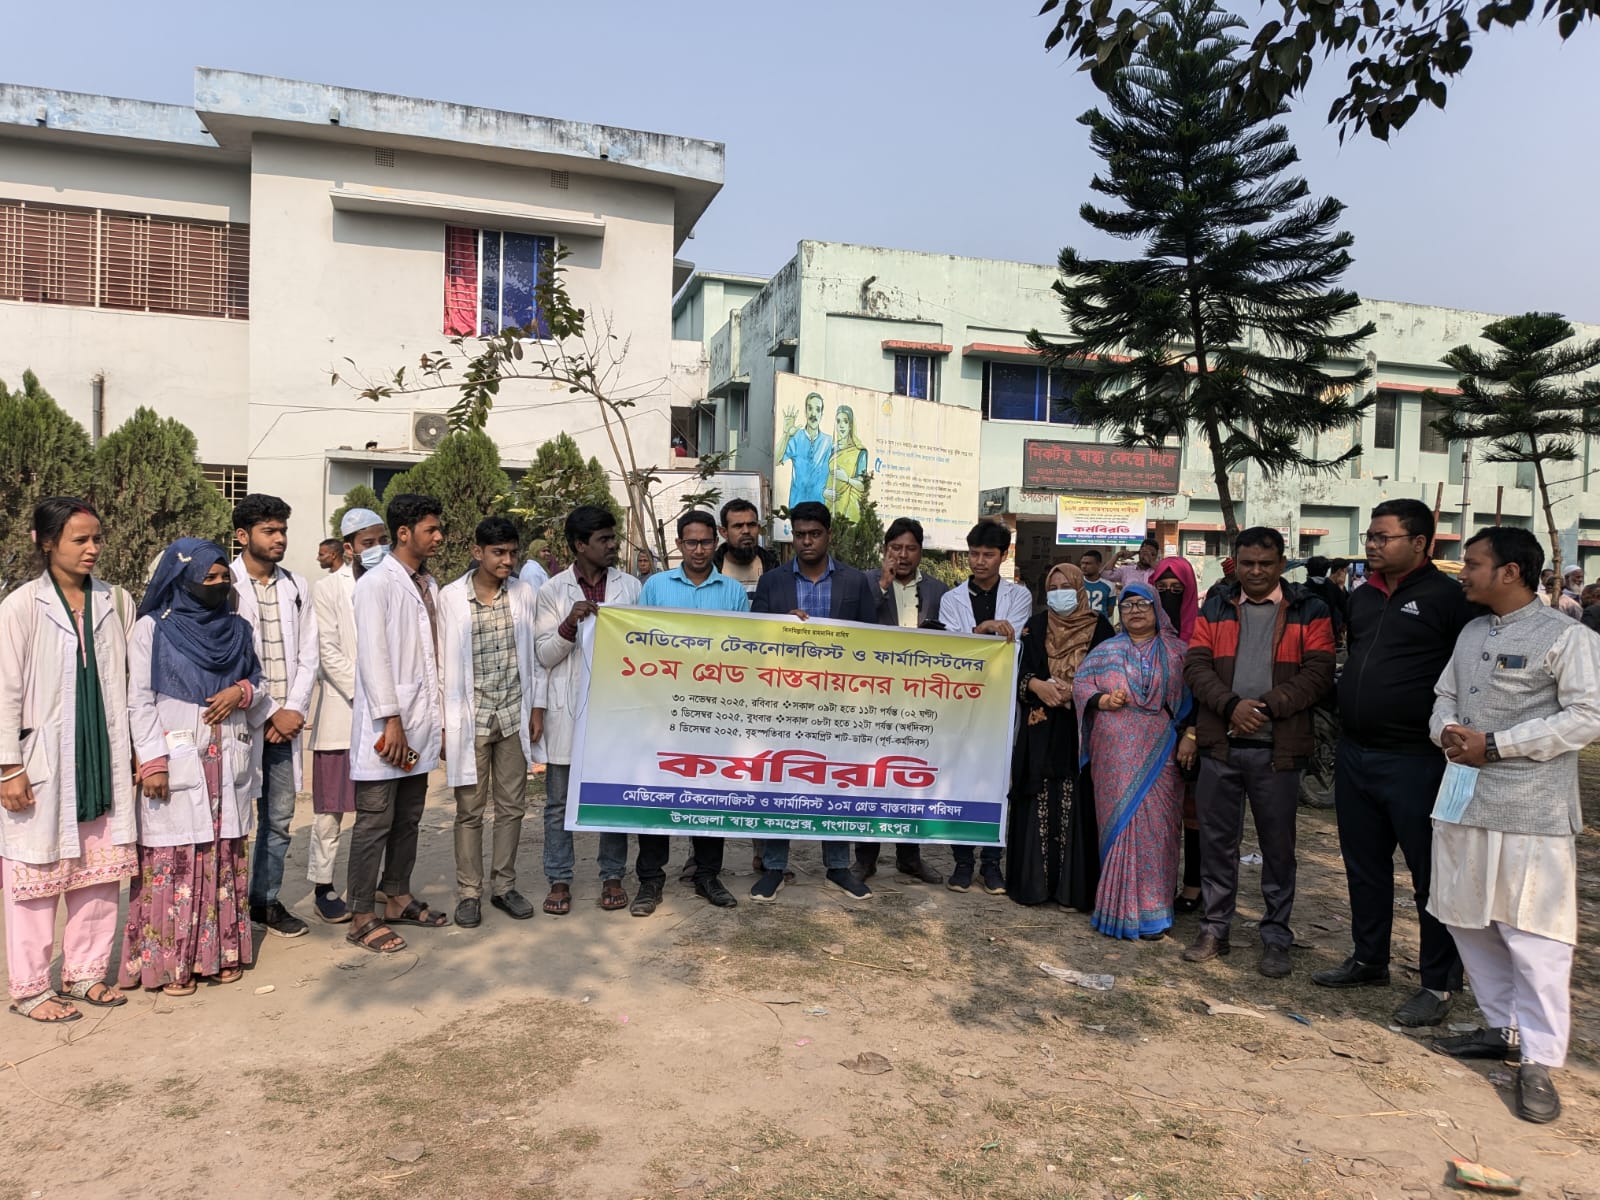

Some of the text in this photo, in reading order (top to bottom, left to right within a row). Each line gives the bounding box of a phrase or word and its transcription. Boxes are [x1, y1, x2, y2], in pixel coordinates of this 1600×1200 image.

[625, 628, 986, 671] মেডিকেল টেকনোলজিস্ট ও ফার্মাসিস্টদের
[621, 656, 986, 700] ১০ম গ্রেড বাস্তবায়নের দাবীতে
[672, 694, 685, 702] ৩০
[688, 694, 717, 705] নভেম্বর
[752, 697, 778, 708] রবিবার
[792, 701, 815, 712] সকাল
[840, 704, 856, 714] হতে
[880, 706, 898, 716] পর্যন্ত
[679, 722, 711, 734] ডিসেম্বর
[745, 727, 791, 739] বৃহস্পতিবার
[681, 707, 713, 720] ডিসেম্বর
[747, 713, 772, 724] বুধবার
[785, 716, 808, 725] সকাল
[834, 719, 850, 728] হতে
[853, 720, 872, 729] ১২টা
[657, 749, 938, 788] কর্মবিরতি
[623, 788, 963, 816] মেডিকেল টেকনোলজিস্ট ও ফার্মাসিস্ট ১০ম গ্রেড বাস্তবায়ন পরিষদ
[669, 811, 724, 826] উপজেলা
[729, 815, 760, 829] স্বাস্থ্য
[763, 816, 816, 832] কমপ্লেক্স,
[821, 820, 874, 833] গংগাচড়া,
